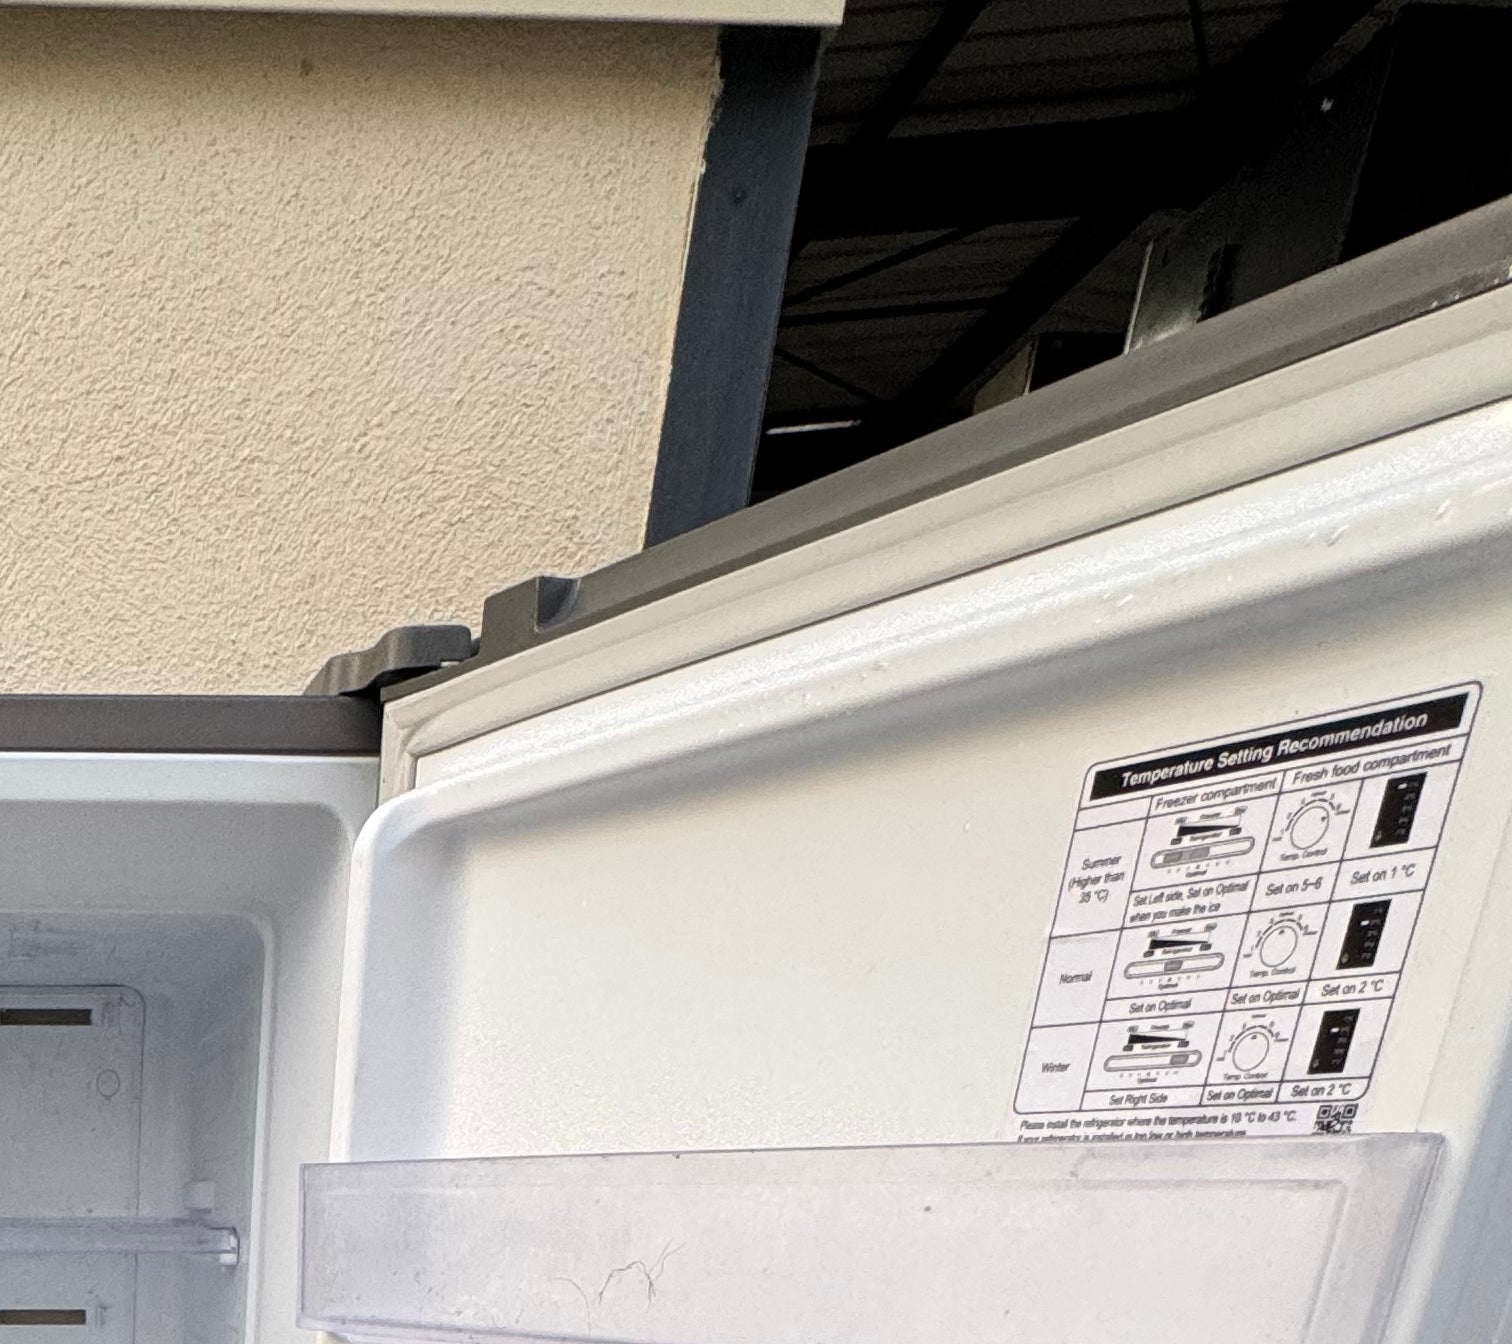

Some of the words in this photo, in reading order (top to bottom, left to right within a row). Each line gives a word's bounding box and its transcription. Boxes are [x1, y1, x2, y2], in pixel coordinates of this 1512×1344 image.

[1121, 756, 1214, 788] Temperature
[1217, 745, 1274, 769] Setting
[1276, 713, 1428, 757] Recommendation
[1292, 768, 1328, 785] Fresh
[1331, 761, 1360, 778] food
[1363, 744, 1452, 772] compartment
[1154, 794, 1198, 810] Freezer
[1200, 777, 1277, 801] compartment
[1081, 855, 1122, 871] Summer
[1103, 871, 1125, 885] than
[1350, 871, 1370, 885] Set
[1372, 870, 1387, 882] on
[1401, 863, 1416, 877] °C
[1202, 886, 1214, 895] on
[1215, 880, 1250, 897] Optimal
[1265, 883, 1282, 896] Set
[1285, 882, 1299, 893] on
[1059, 971, 1093, 985] Normal
[1321, 983, 1340, 997] Set
[1342, 984, 1356, 995] on
[1358, 981, 1367, 994] 2
[1370, 979, 1384, 992] °C
[1230, 993, 1247, 1005] Set
[1249, 992, 1261, 1003] on
[1262, 989, 1301, 1004] Optimal
[1129, 1002, 1144, 1015] Set
[1144, 1002, 1156, 1012] on
[1157, 998, 1192, 1014] Optimal
[1041, 1062, 1071, 1074] Winter
[1206, 1090, 1222, 1101] Set
[1223, 1089, 1235, 1100] on
[1237, 1087, 1275, 1102] Optimal
[1290, 1085, 1309, 1097] Set
[1311, 1086, 1325, 1096] on
[1326, 1085, 1335, 1096] 2
[1338, 1083, 1352, 1096] °C
[1268, 1110, 1281, 1122] 43
